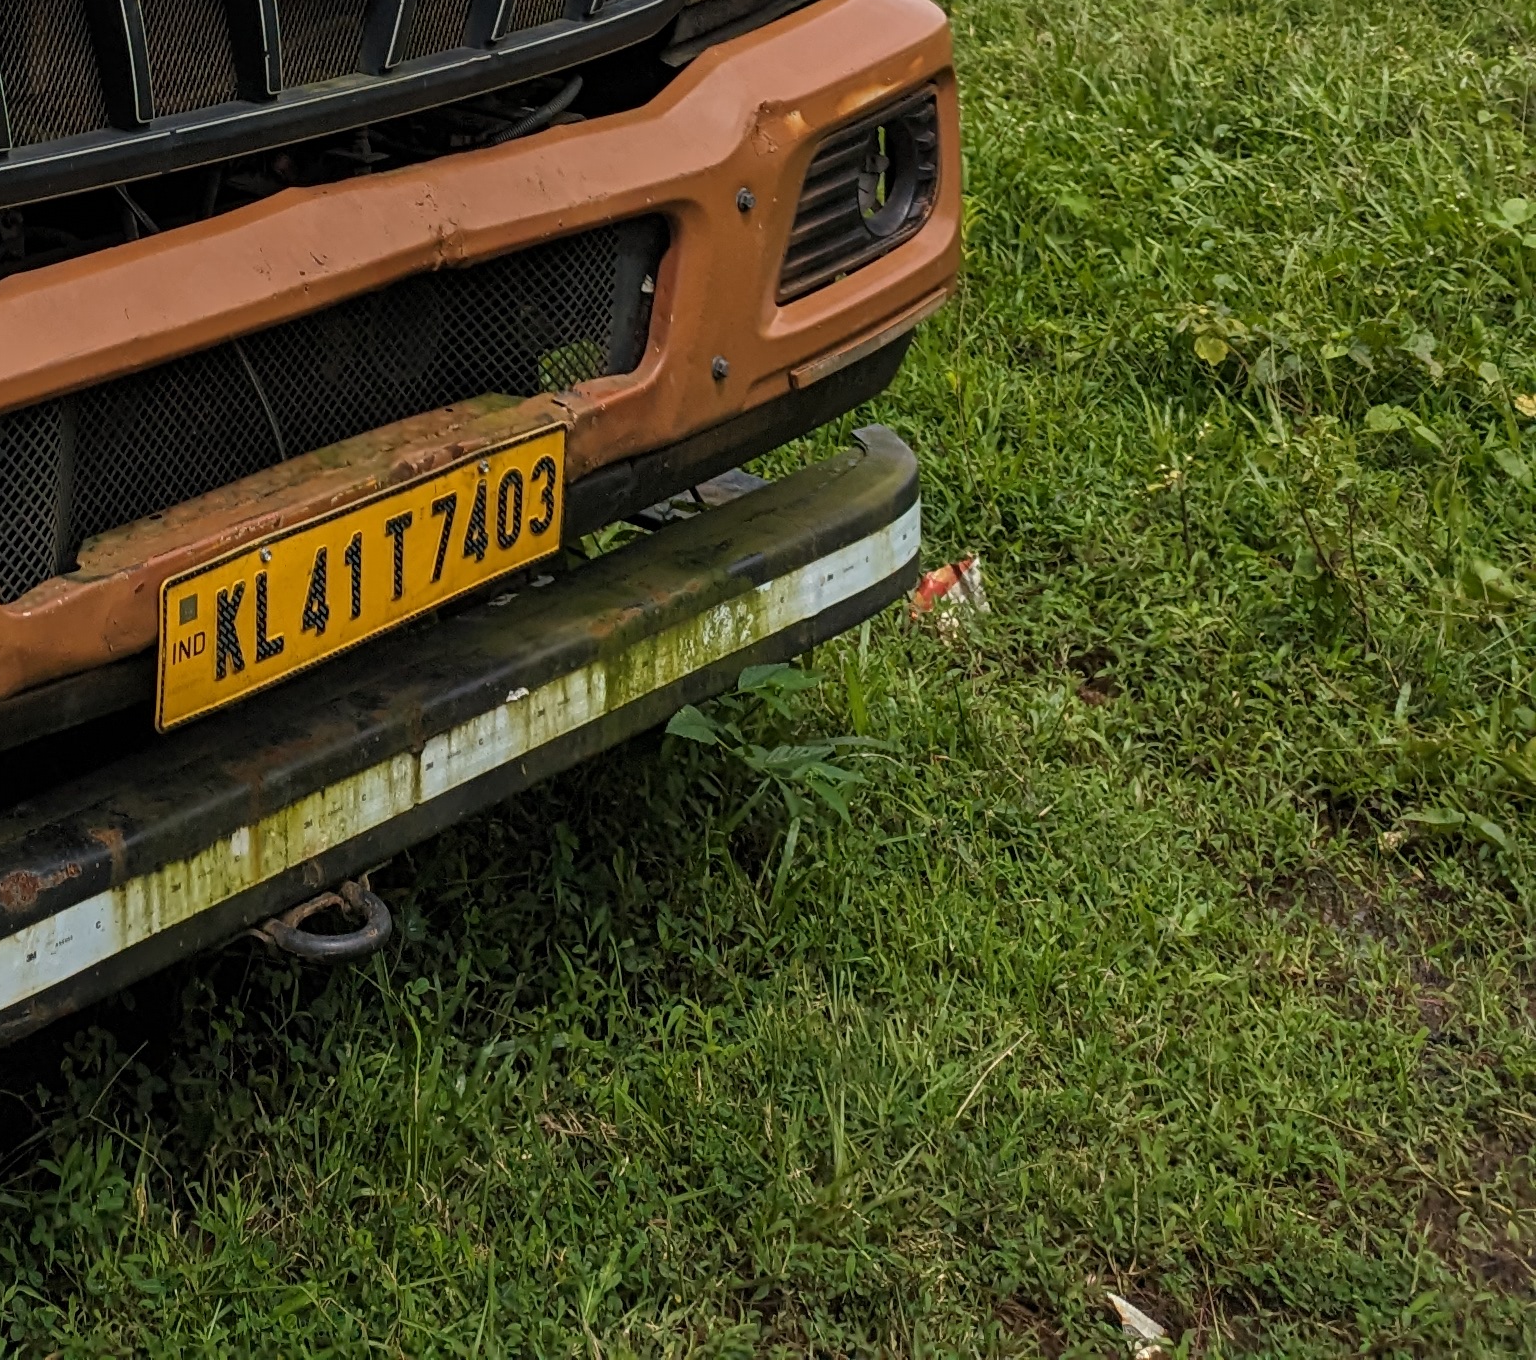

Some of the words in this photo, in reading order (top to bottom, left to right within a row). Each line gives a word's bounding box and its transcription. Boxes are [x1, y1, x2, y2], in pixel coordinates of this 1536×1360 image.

[215, 571, 284, 680] KL
[302, 530, 363, 636] 41
[385, 511, 413, 600] T
[431, 454, 557, 583] 7403
[172, 630, 206, 665] IND
